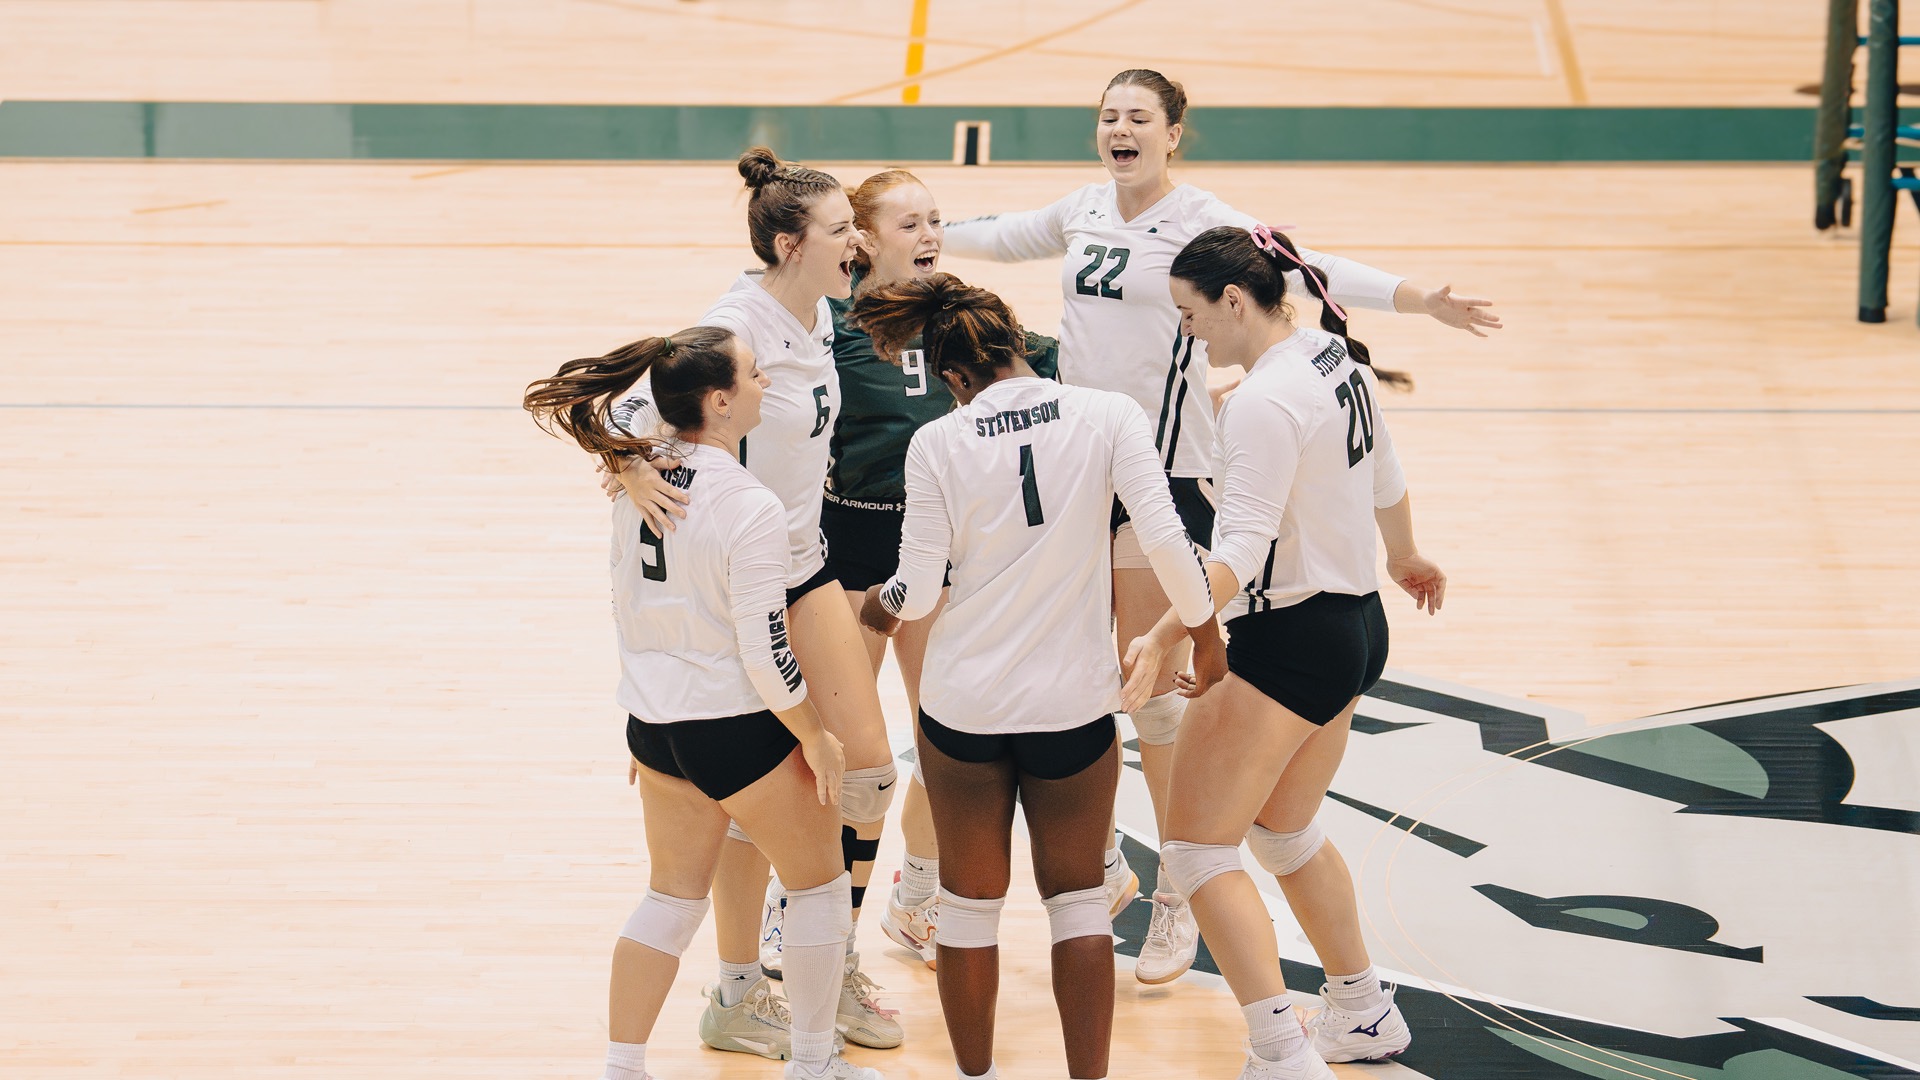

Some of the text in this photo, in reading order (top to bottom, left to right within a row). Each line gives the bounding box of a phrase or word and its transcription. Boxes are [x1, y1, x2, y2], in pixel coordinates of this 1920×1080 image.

[1076, 244, 1131, 300] 22
[901, 348, 927, 397] 9
[810, 384, 830, 438] 6
[975, 398, 1060, 437] STEVENSON
[1335, 368, 1373, 469] 20
[841, 498, 894, 511] ARMOUR
[1019, 443, 1044, 527] 1
